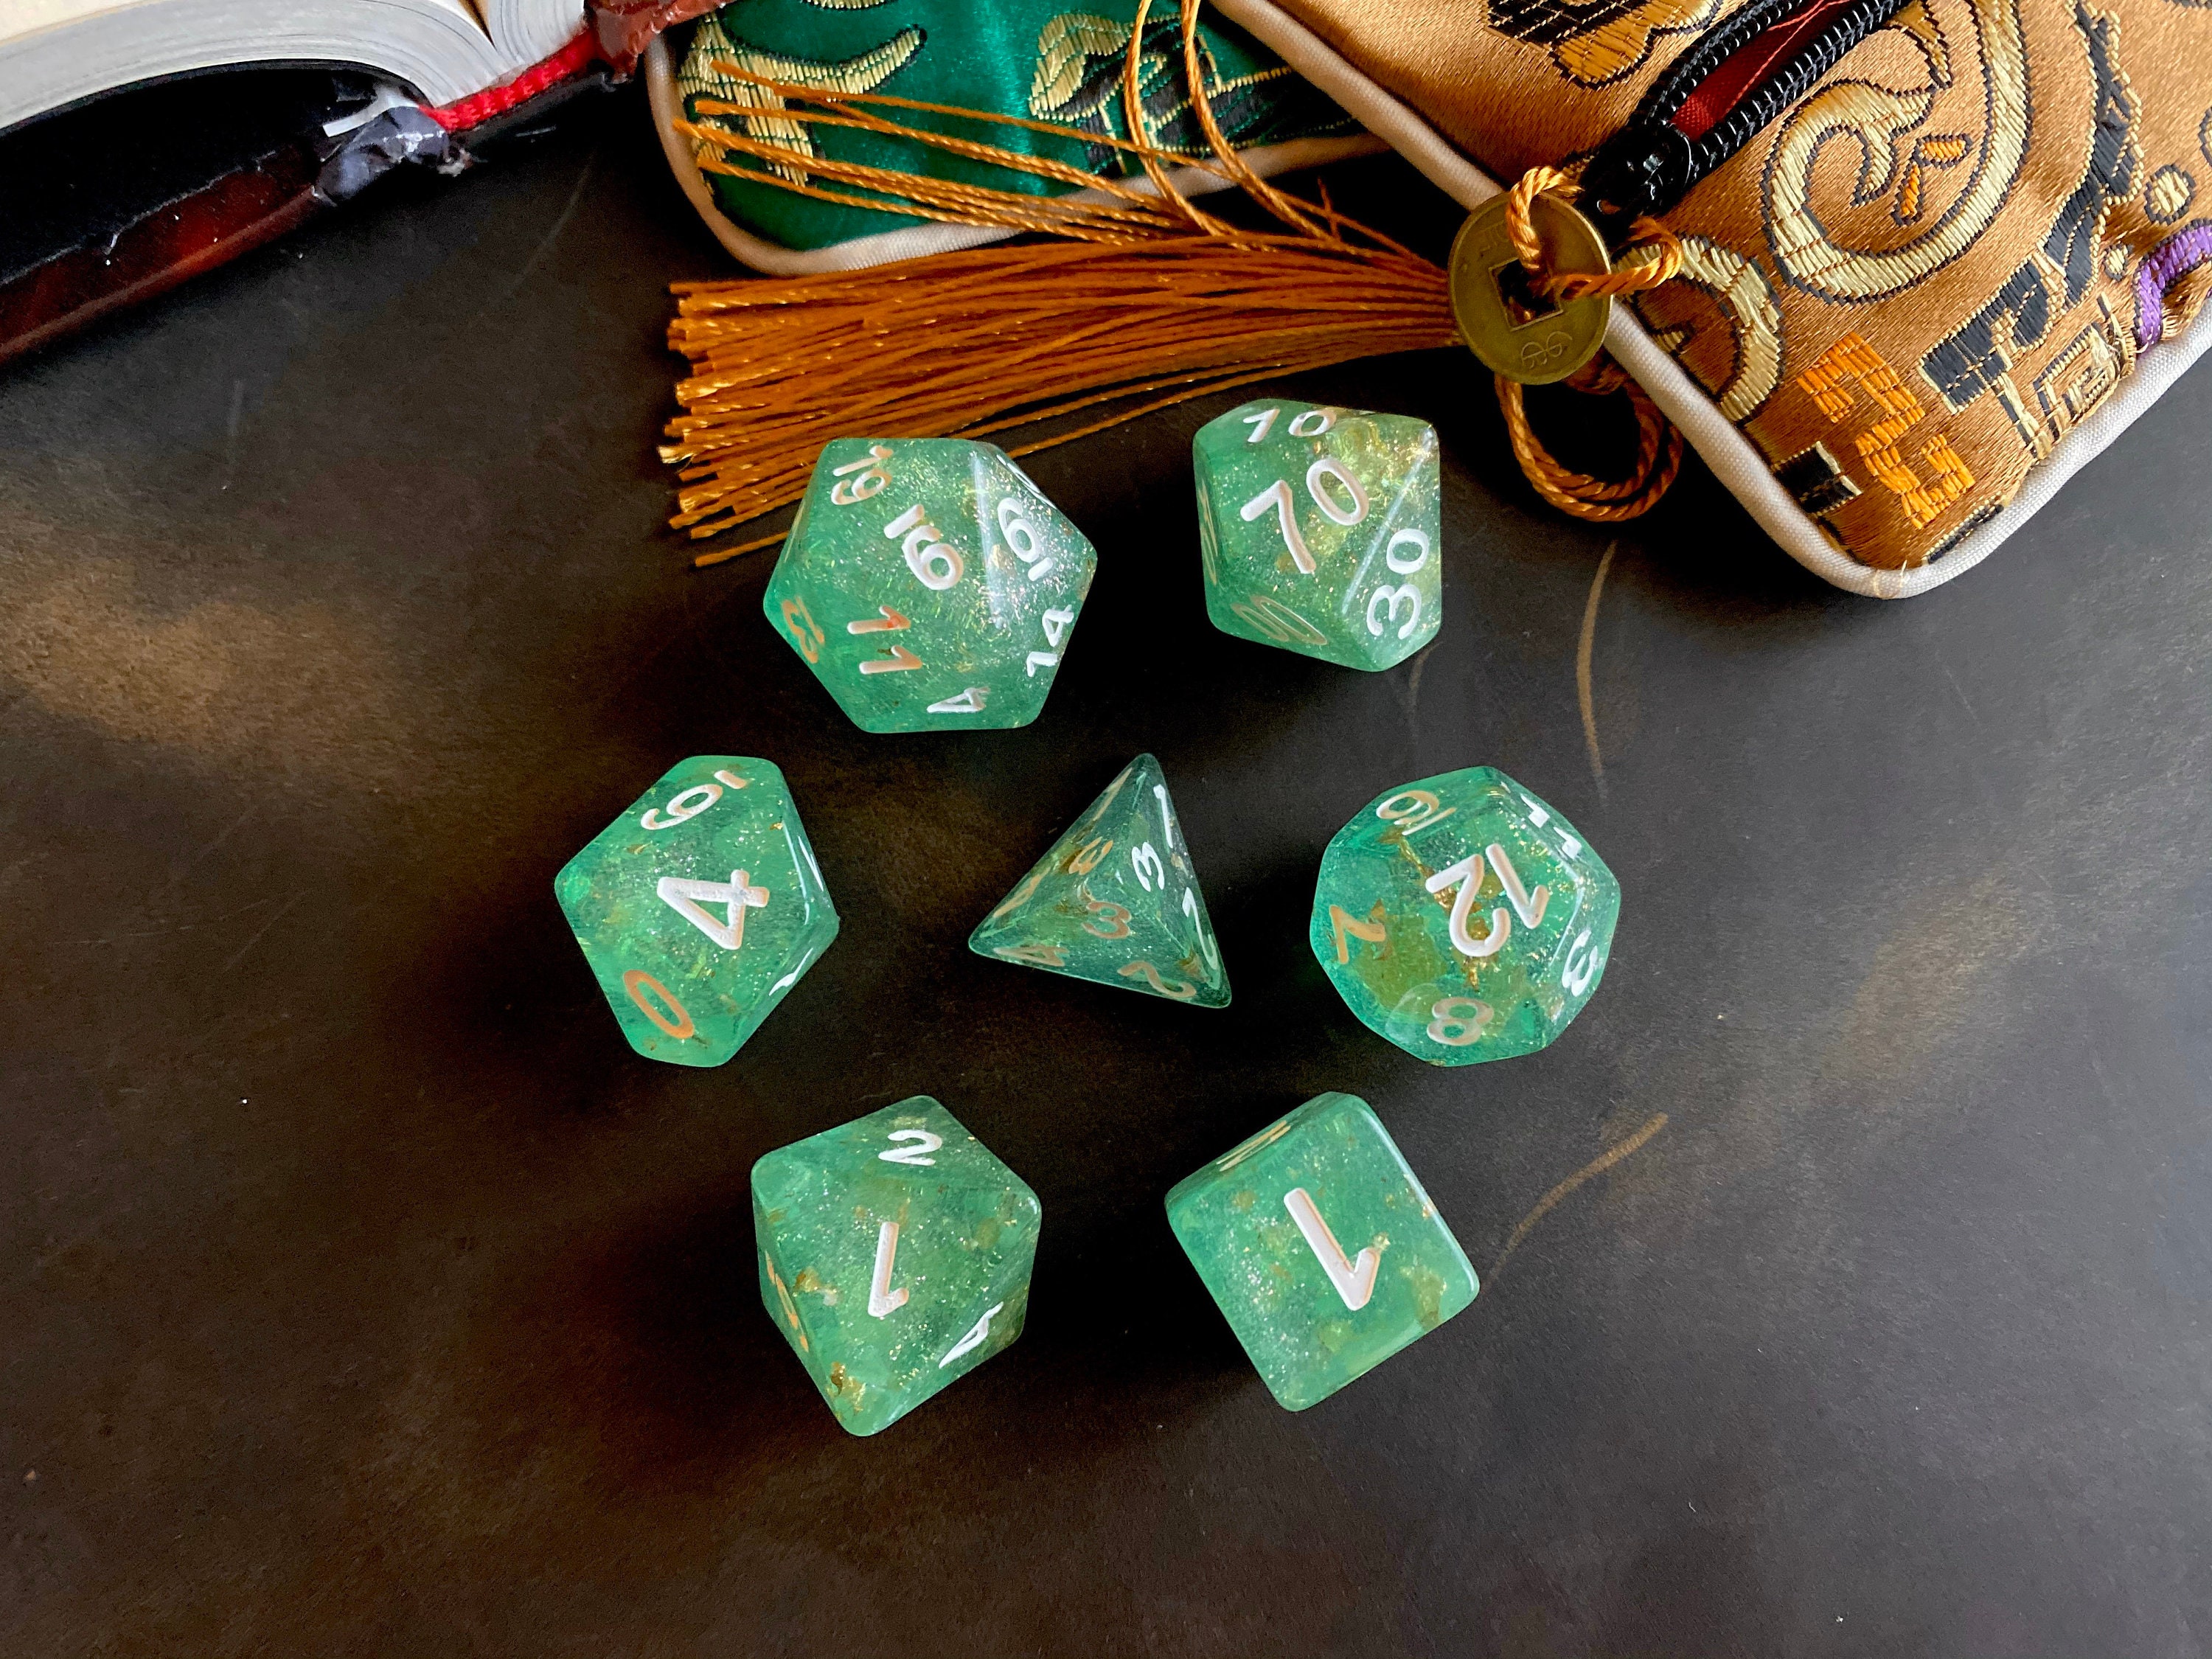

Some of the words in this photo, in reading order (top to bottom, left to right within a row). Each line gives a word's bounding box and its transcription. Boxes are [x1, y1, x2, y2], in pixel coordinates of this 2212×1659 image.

[1243, 408, 1337, 442] 10
[1239, 455, 1369, 574] 70
[1366, 527, 1430, 640] 30
[1131, 841, 1165, 893] 3
[1425, 843, 1550, 958] 12
[656, 869, 770, 950] 4
[1082, 901, 1133, 939] 3
[623, 969, 695, 1040] 0
[1427, 997, 1494, 1046] 8
[878, 1129, 942, 1166] 2
[1284, 1187, 1381, 1311] 1
